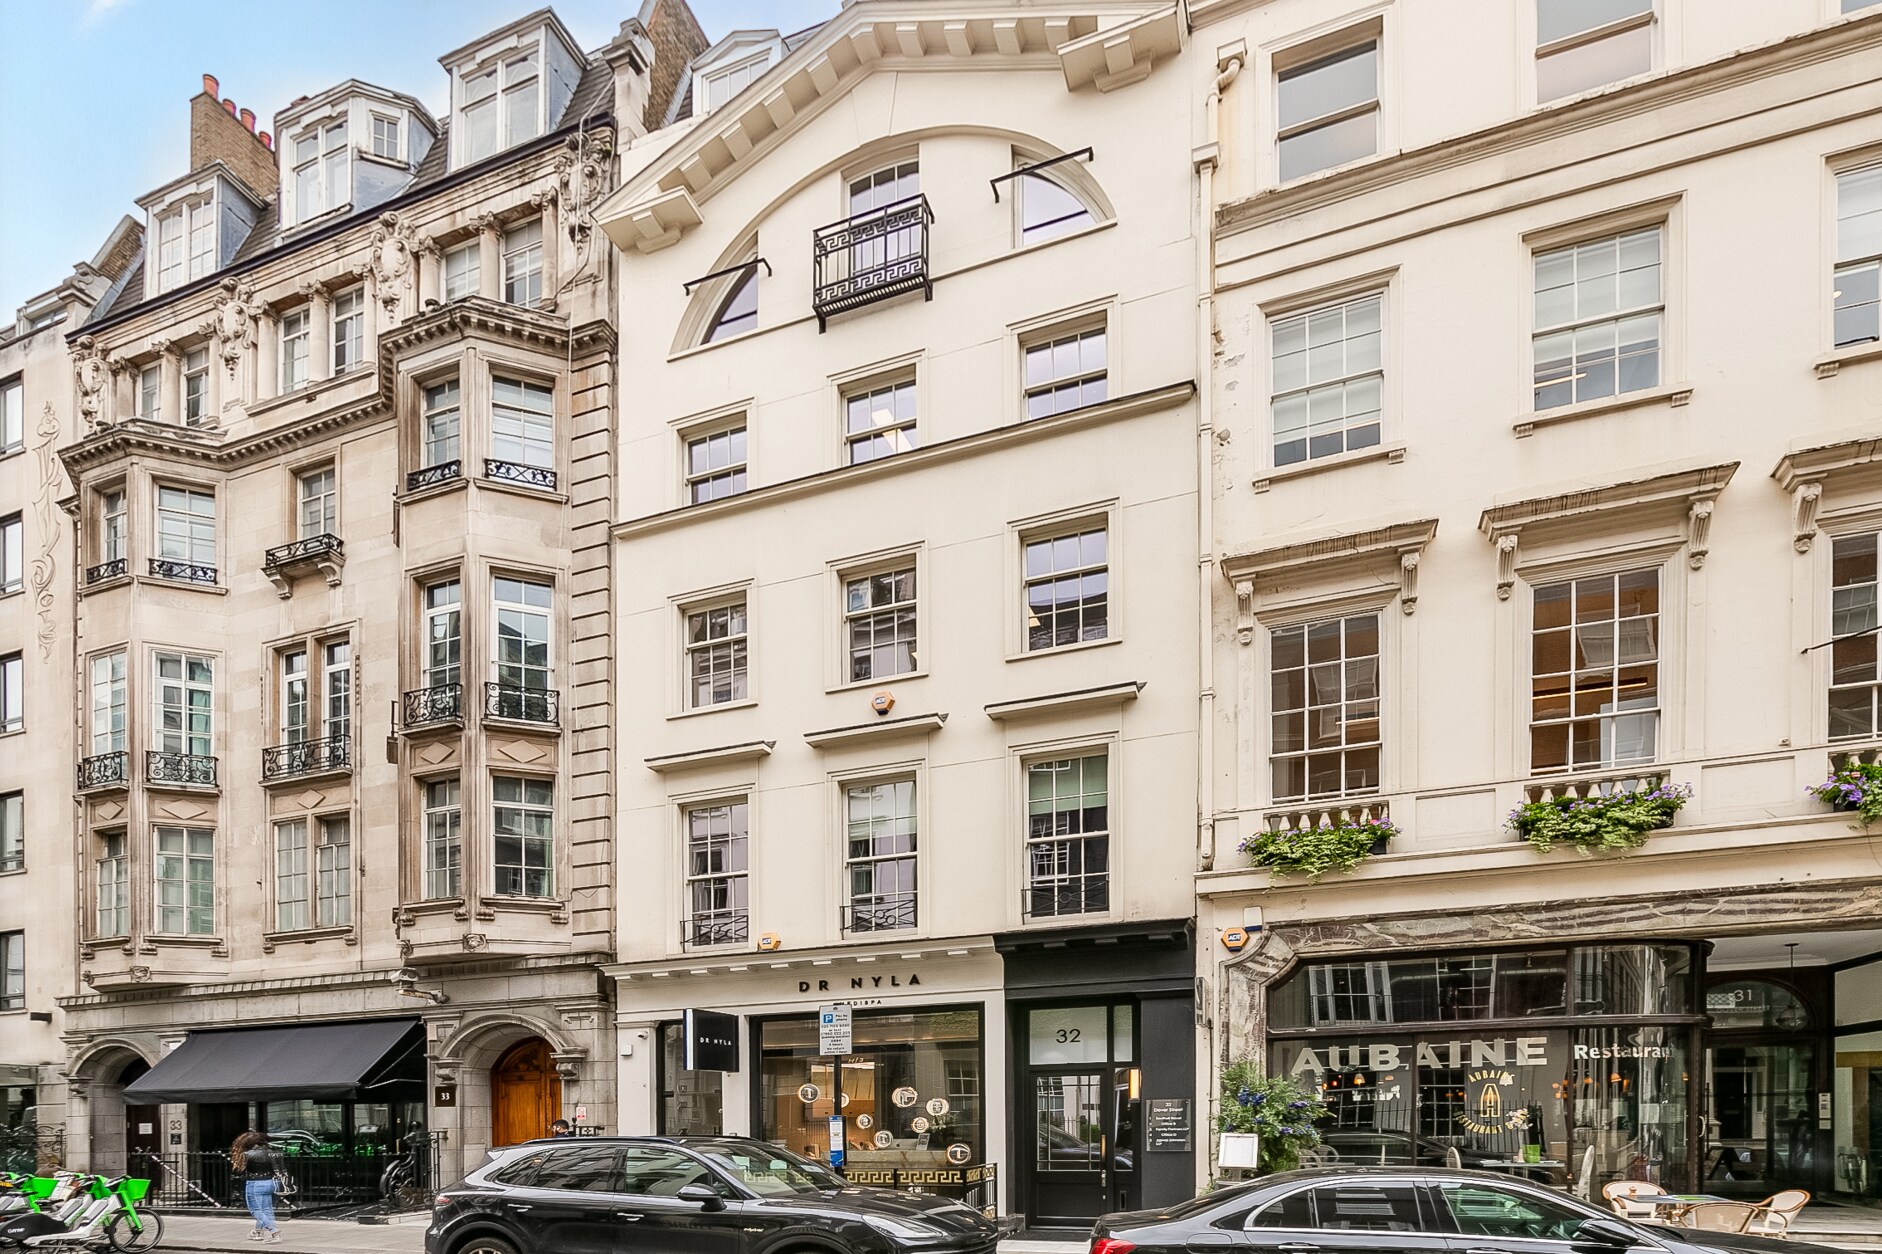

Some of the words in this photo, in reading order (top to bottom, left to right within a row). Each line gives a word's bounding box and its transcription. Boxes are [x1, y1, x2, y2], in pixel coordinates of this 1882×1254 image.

[799, 980, 829, 993] DR
[851, 974, 920, 989] NYLA
[1734, 989, 1752, 1002] 31
[713, 1038, 732, 1046] NYLA
[1056, 1029, 1081, 1043] 32
[1290, 1036, 1548, 1076] AUBAINE
[440, 1092, 450, 1100] 33
[169, 1120, 182, 1130] 33
